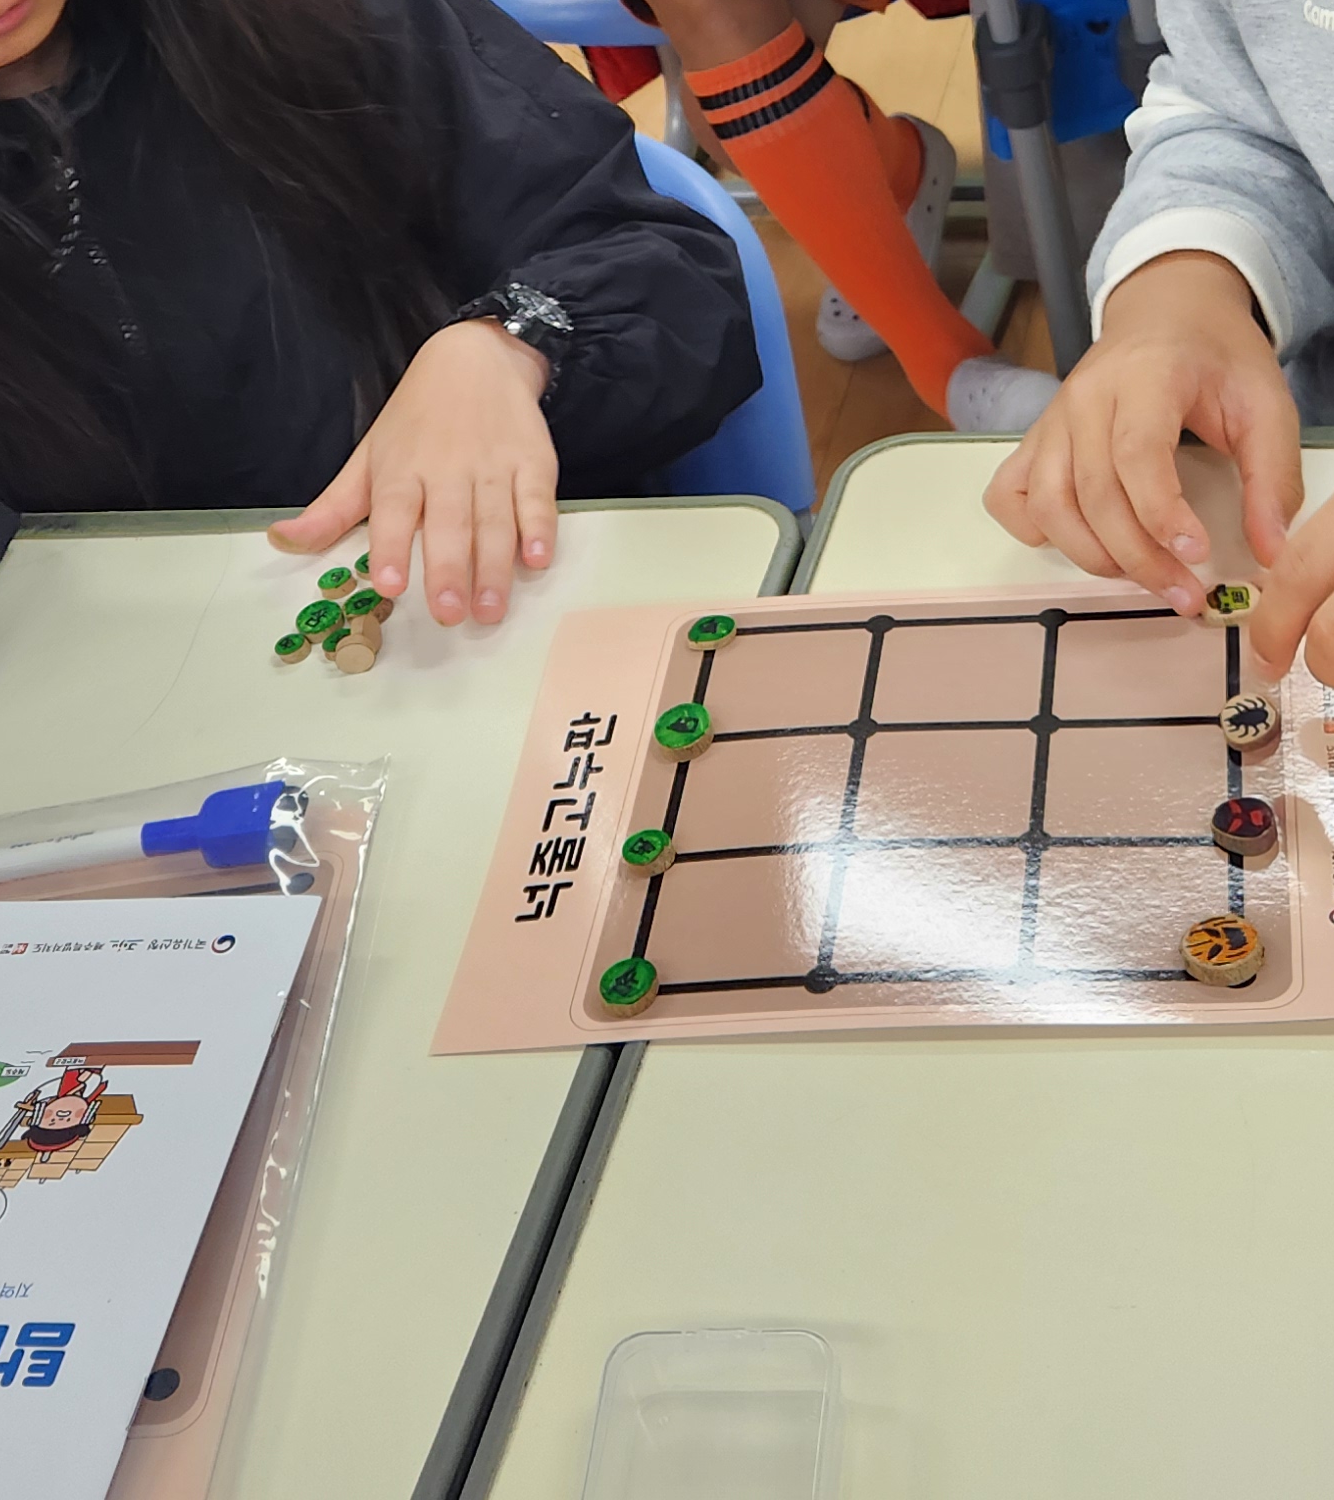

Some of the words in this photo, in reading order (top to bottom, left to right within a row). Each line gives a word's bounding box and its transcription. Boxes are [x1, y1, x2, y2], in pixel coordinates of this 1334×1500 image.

[514, 711, 620, 923] 넉줄고누판
[31, 941, 106, 954] 제주특별자치도
[146, 938, 208, 951] 국가유산청
